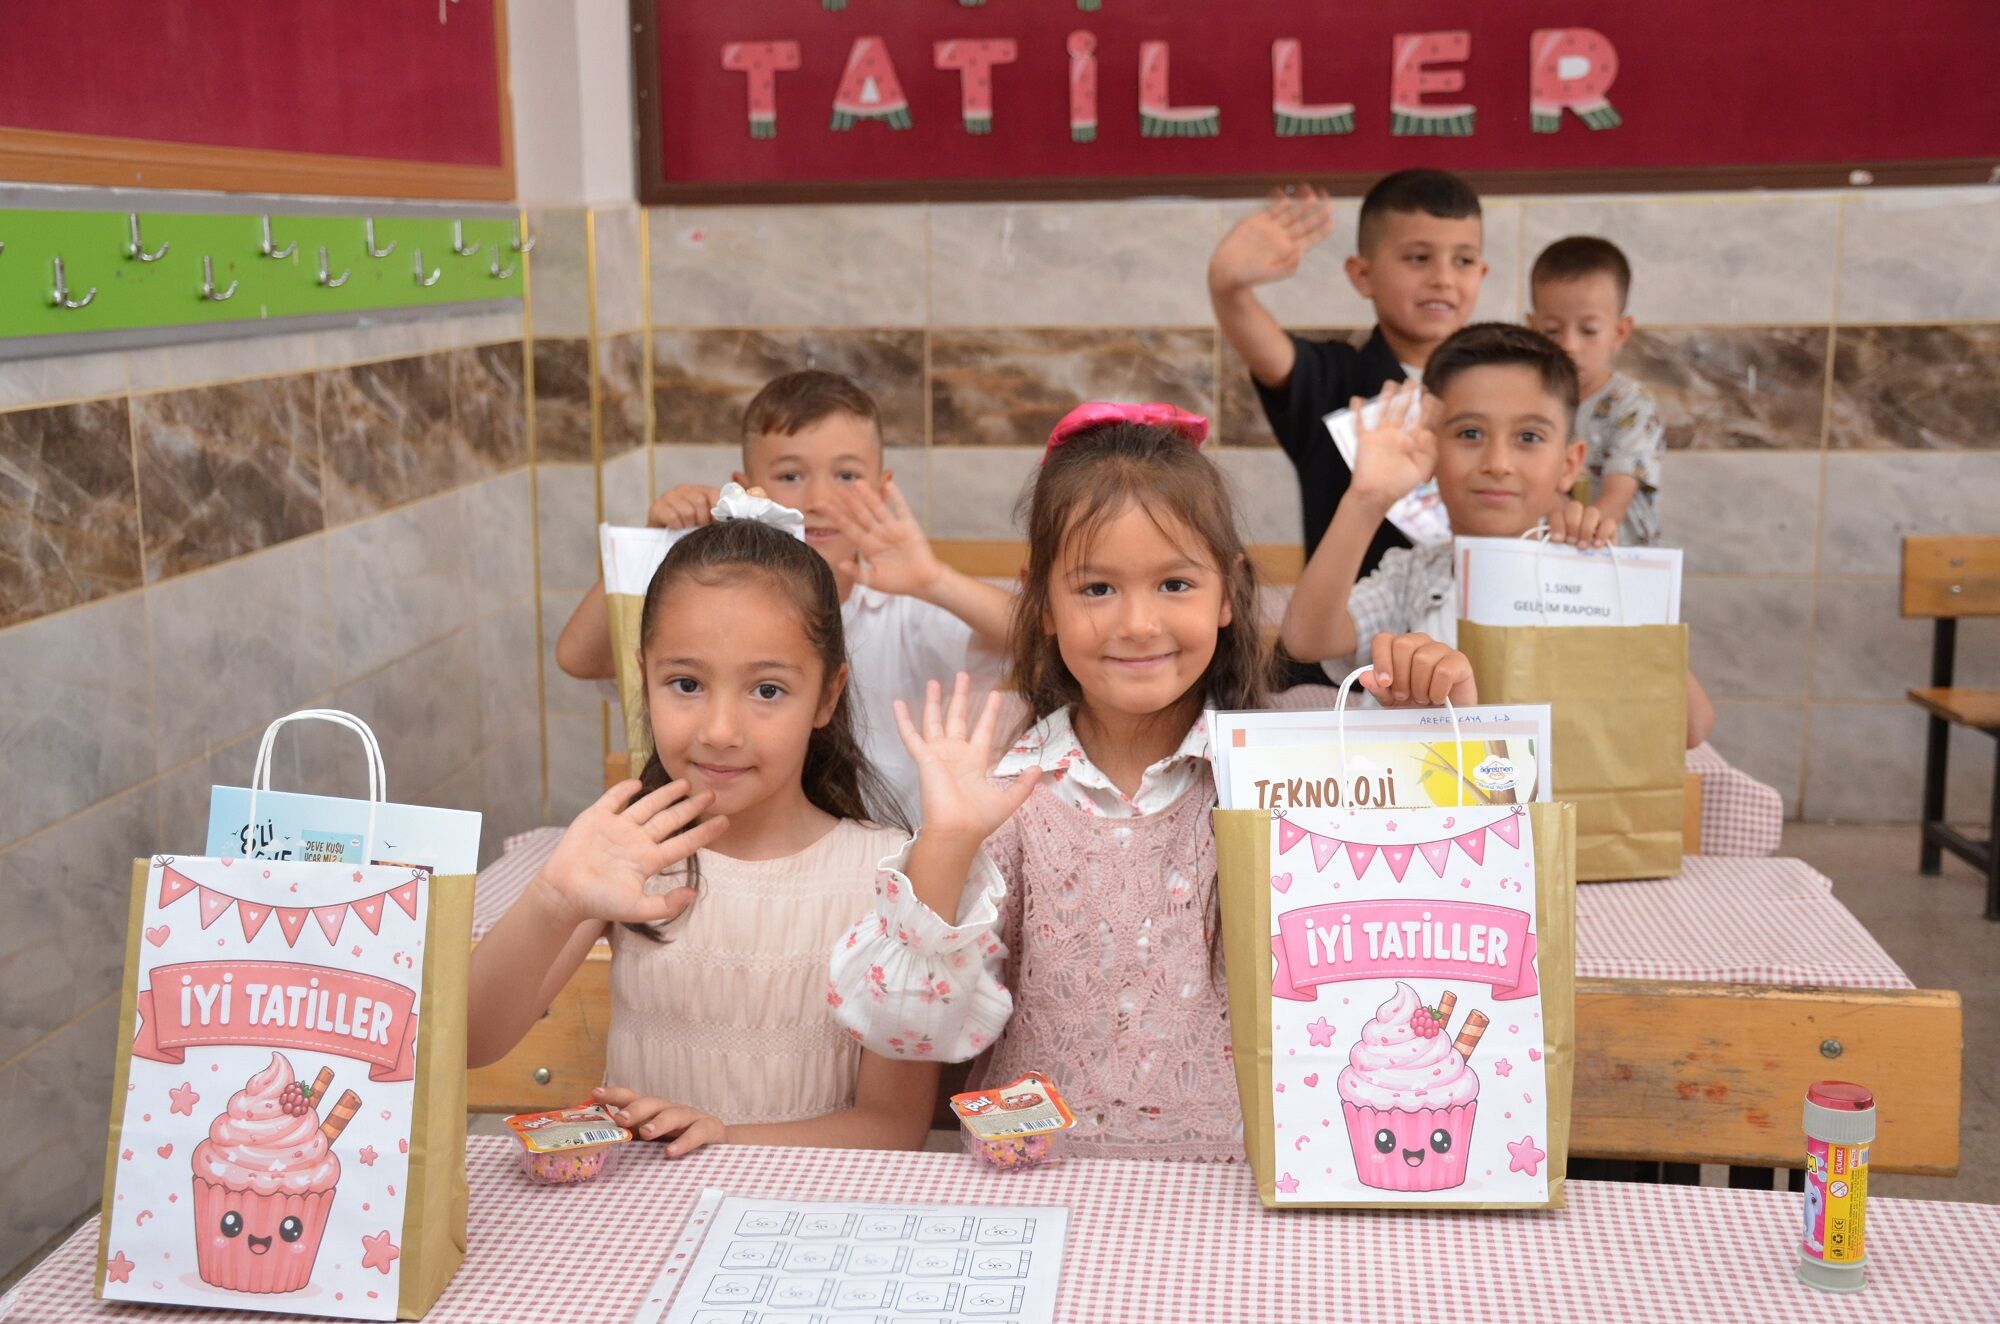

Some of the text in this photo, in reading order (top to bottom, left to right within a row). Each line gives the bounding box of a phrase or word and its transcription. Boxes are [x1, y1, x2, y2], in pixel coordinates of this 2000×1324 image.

[720, 27, 1623, 142] TATİLLER
[1563, 603, 1611, 617] RAPORU
[1253, 767, 1396, 809] TEKNOOJİ
[1304, 911, 1510, 968] İYİ TATİLLER
[180, 973, 394, 1045] İYİ TATİLLER
